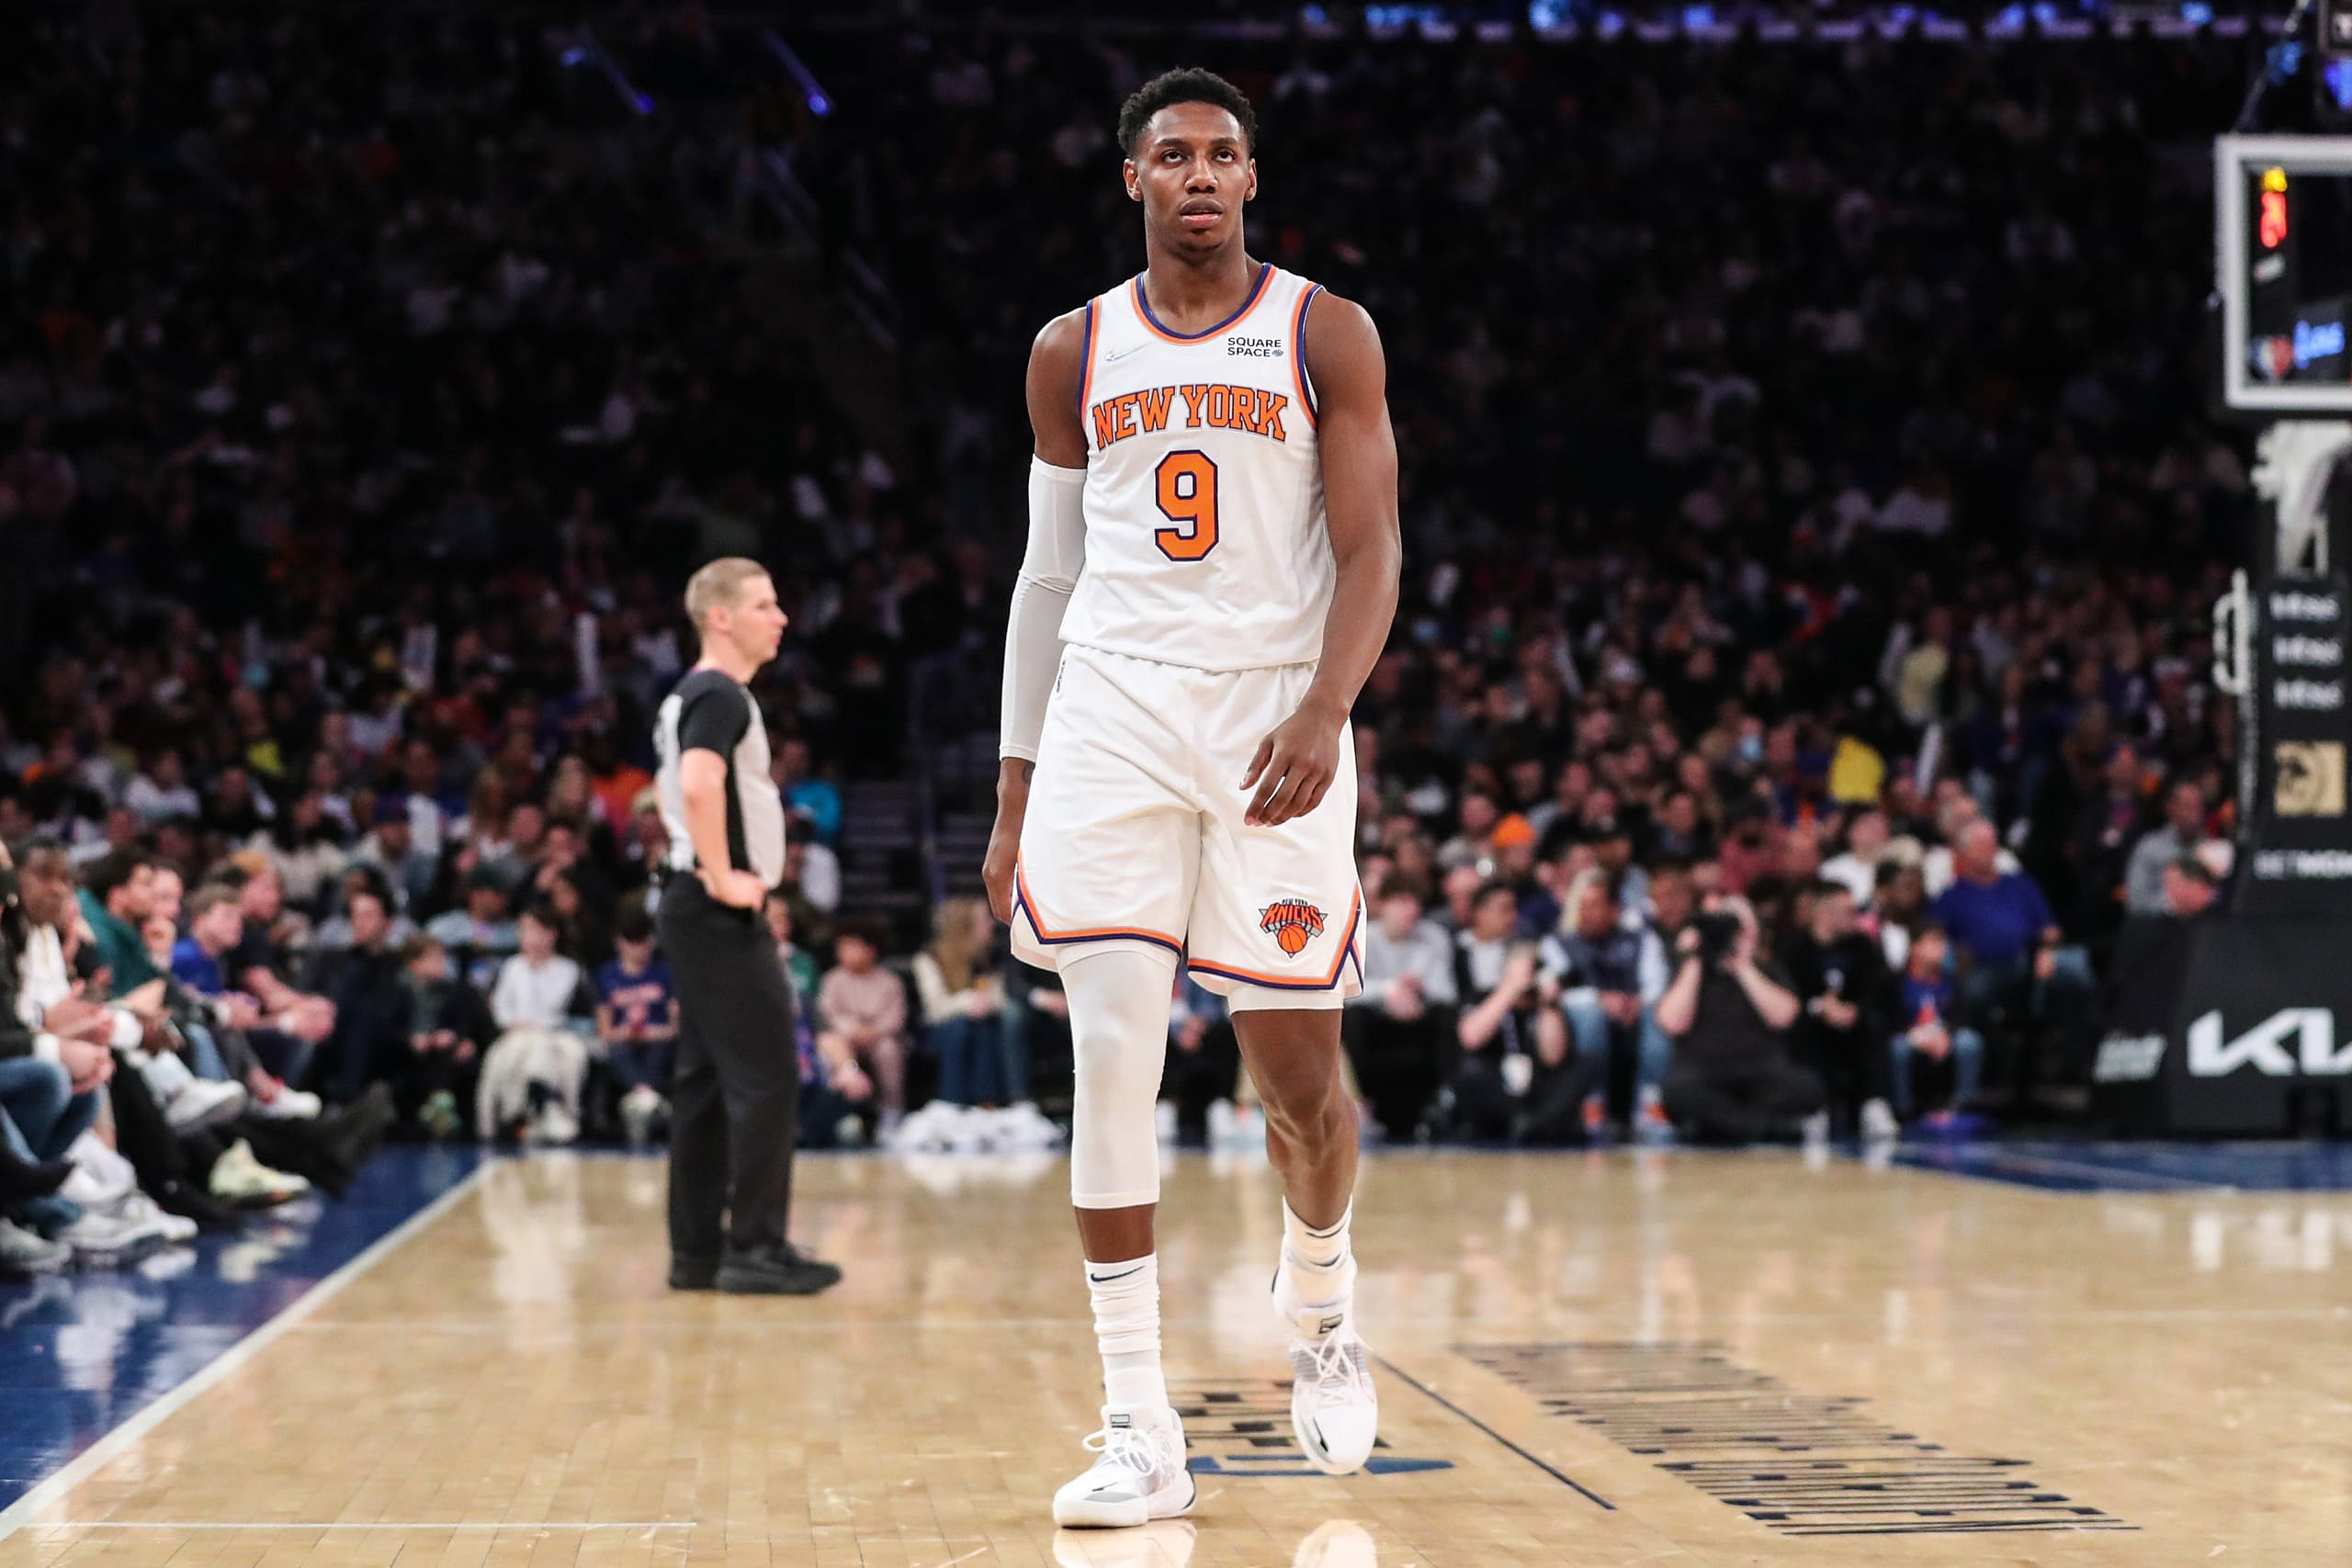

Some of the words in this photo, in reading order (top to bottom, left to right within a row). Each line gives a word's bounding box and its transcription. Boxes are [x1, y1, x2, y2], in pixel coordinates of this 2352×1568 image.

[1227, 337, 1282, 347] SQUARE
[1227, 347, 1271, 357] SPACE
[1092, 385, 1176, 452] NEW
[1181, 384, 1288, 442] YORK
[1154, 449, 1219, 561] 9
[1260, 902, 1325, 933] KNICKS
